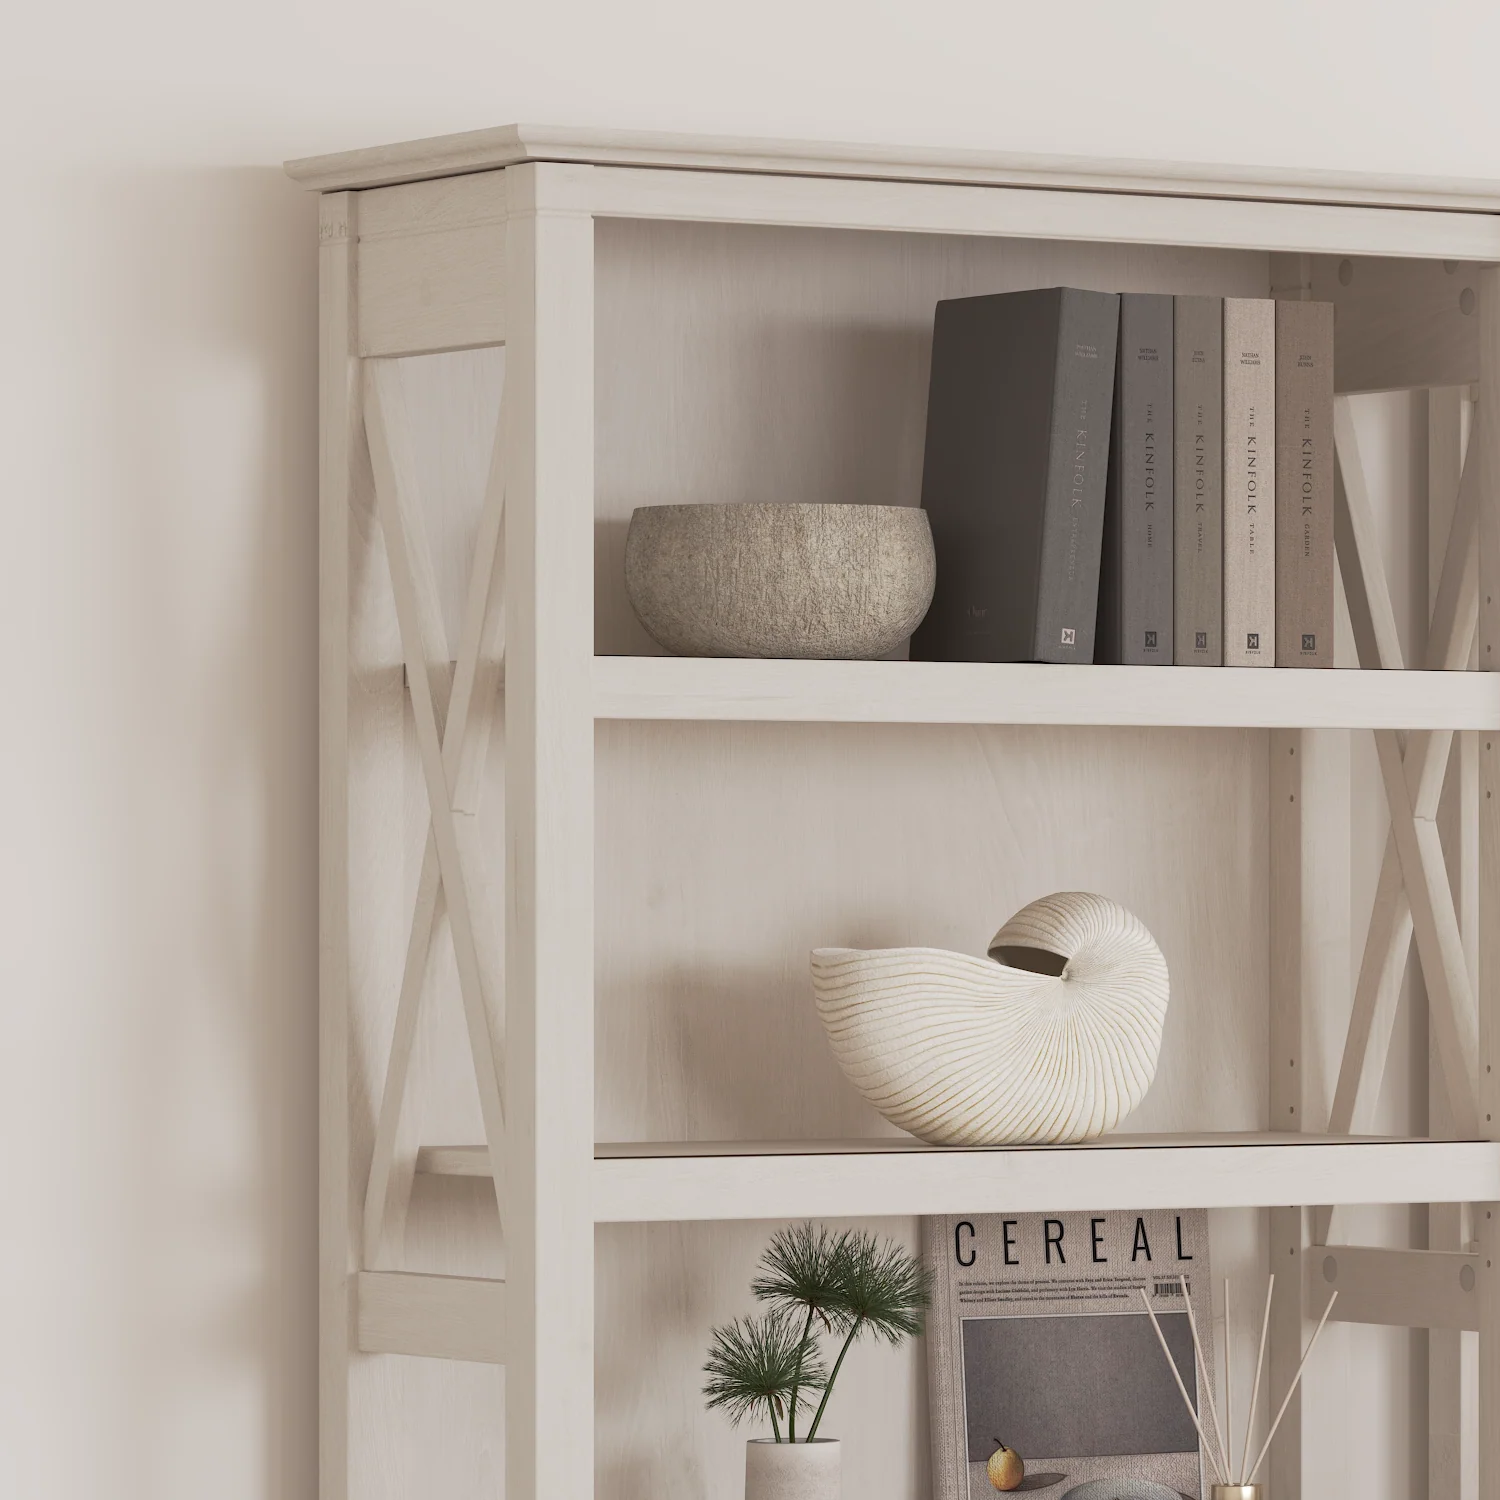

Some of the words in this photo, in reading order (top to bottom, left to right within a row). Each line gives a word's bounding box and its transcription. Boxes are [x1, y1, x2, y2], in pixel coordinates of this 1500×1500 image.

[1071, 429, 1088, 508] KINFOLK
[1145, 432, 1155, 512] KINFOLK
[1195, 434, 1205, 513] KINFOLK
[1247, 436, 1257, 515] KINFOLK
[1301, 438, 1313, 516] KINFOLK
[955, 1216, 1193, 1267] CEREAL
